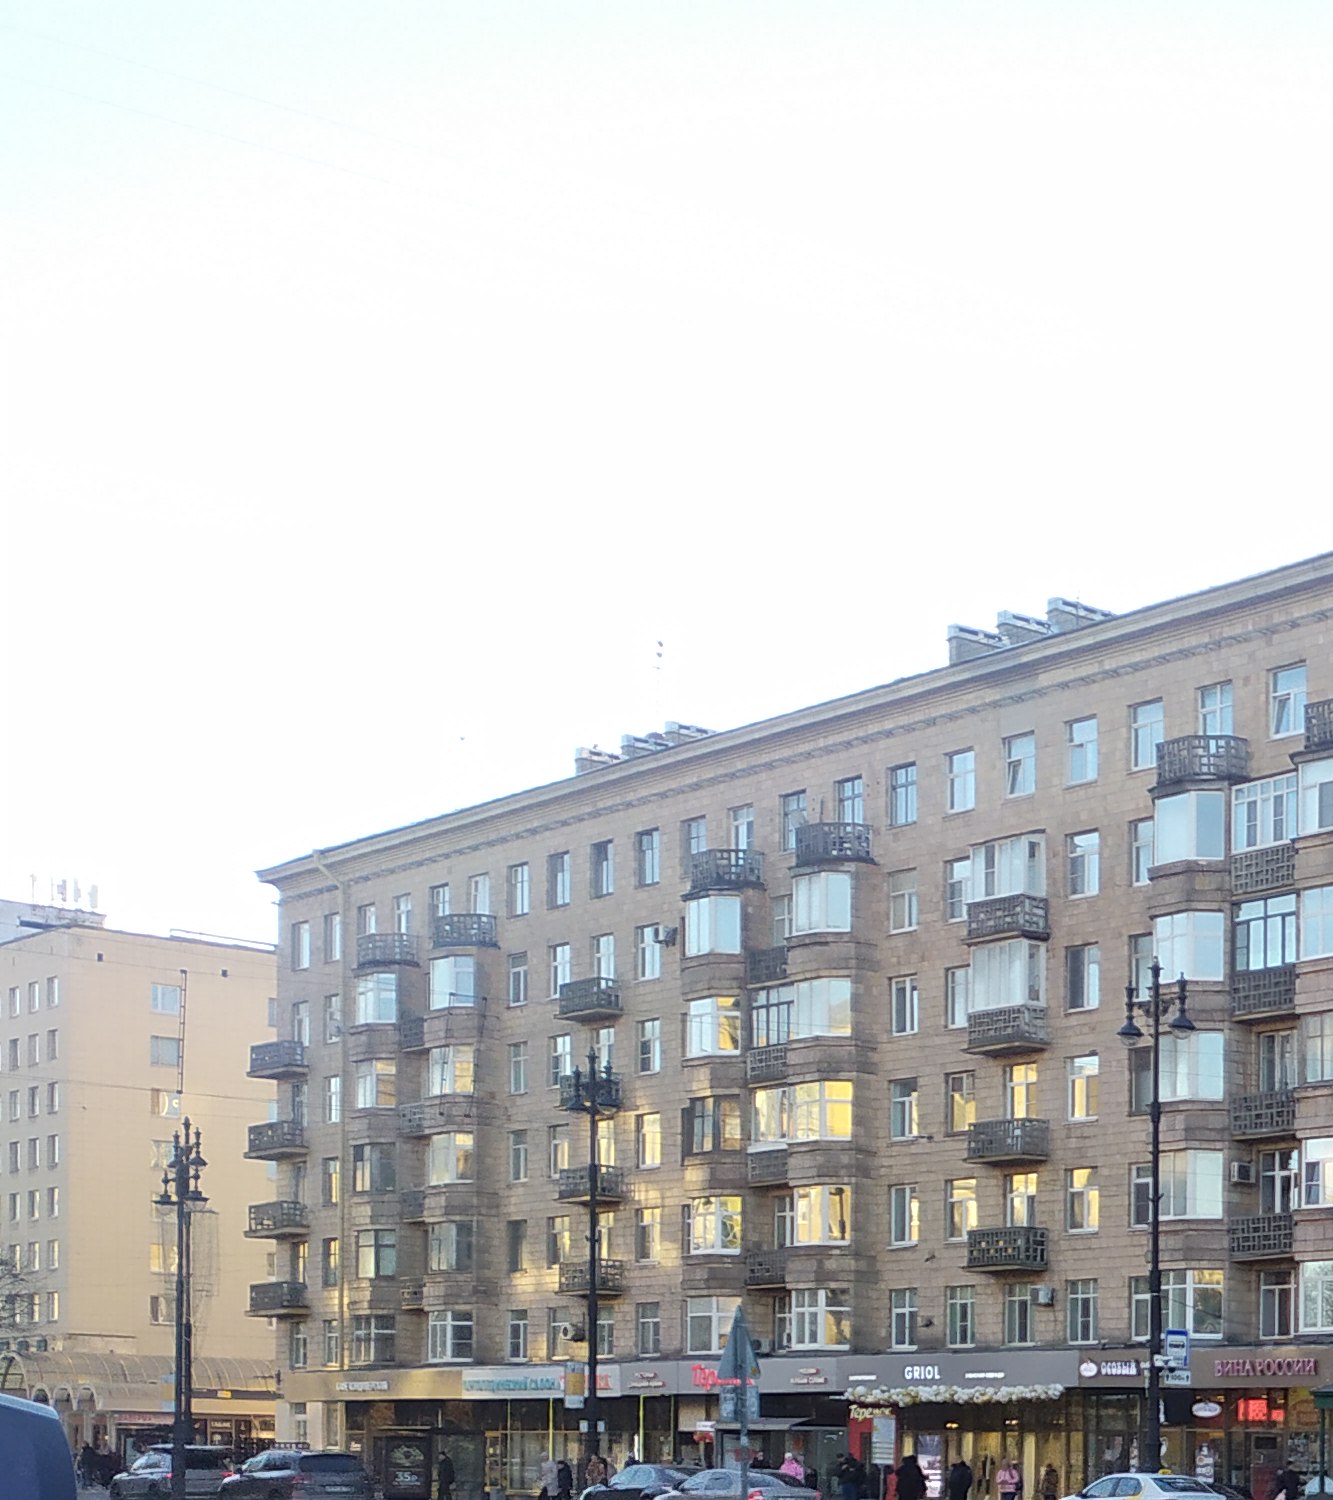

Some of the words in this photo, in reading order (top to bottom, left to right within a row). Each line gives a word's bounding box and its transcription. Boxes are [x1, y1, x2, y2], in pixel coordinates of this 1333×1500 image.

[904, 1365, 941, 1380] GRIOL
[1100, 1359, 1138, 1376] ОСОБЫЙ
[1214, 1359, 1252, 1377] ВИНА
[1256, 1357, 1316, 1376] РОССИИ
